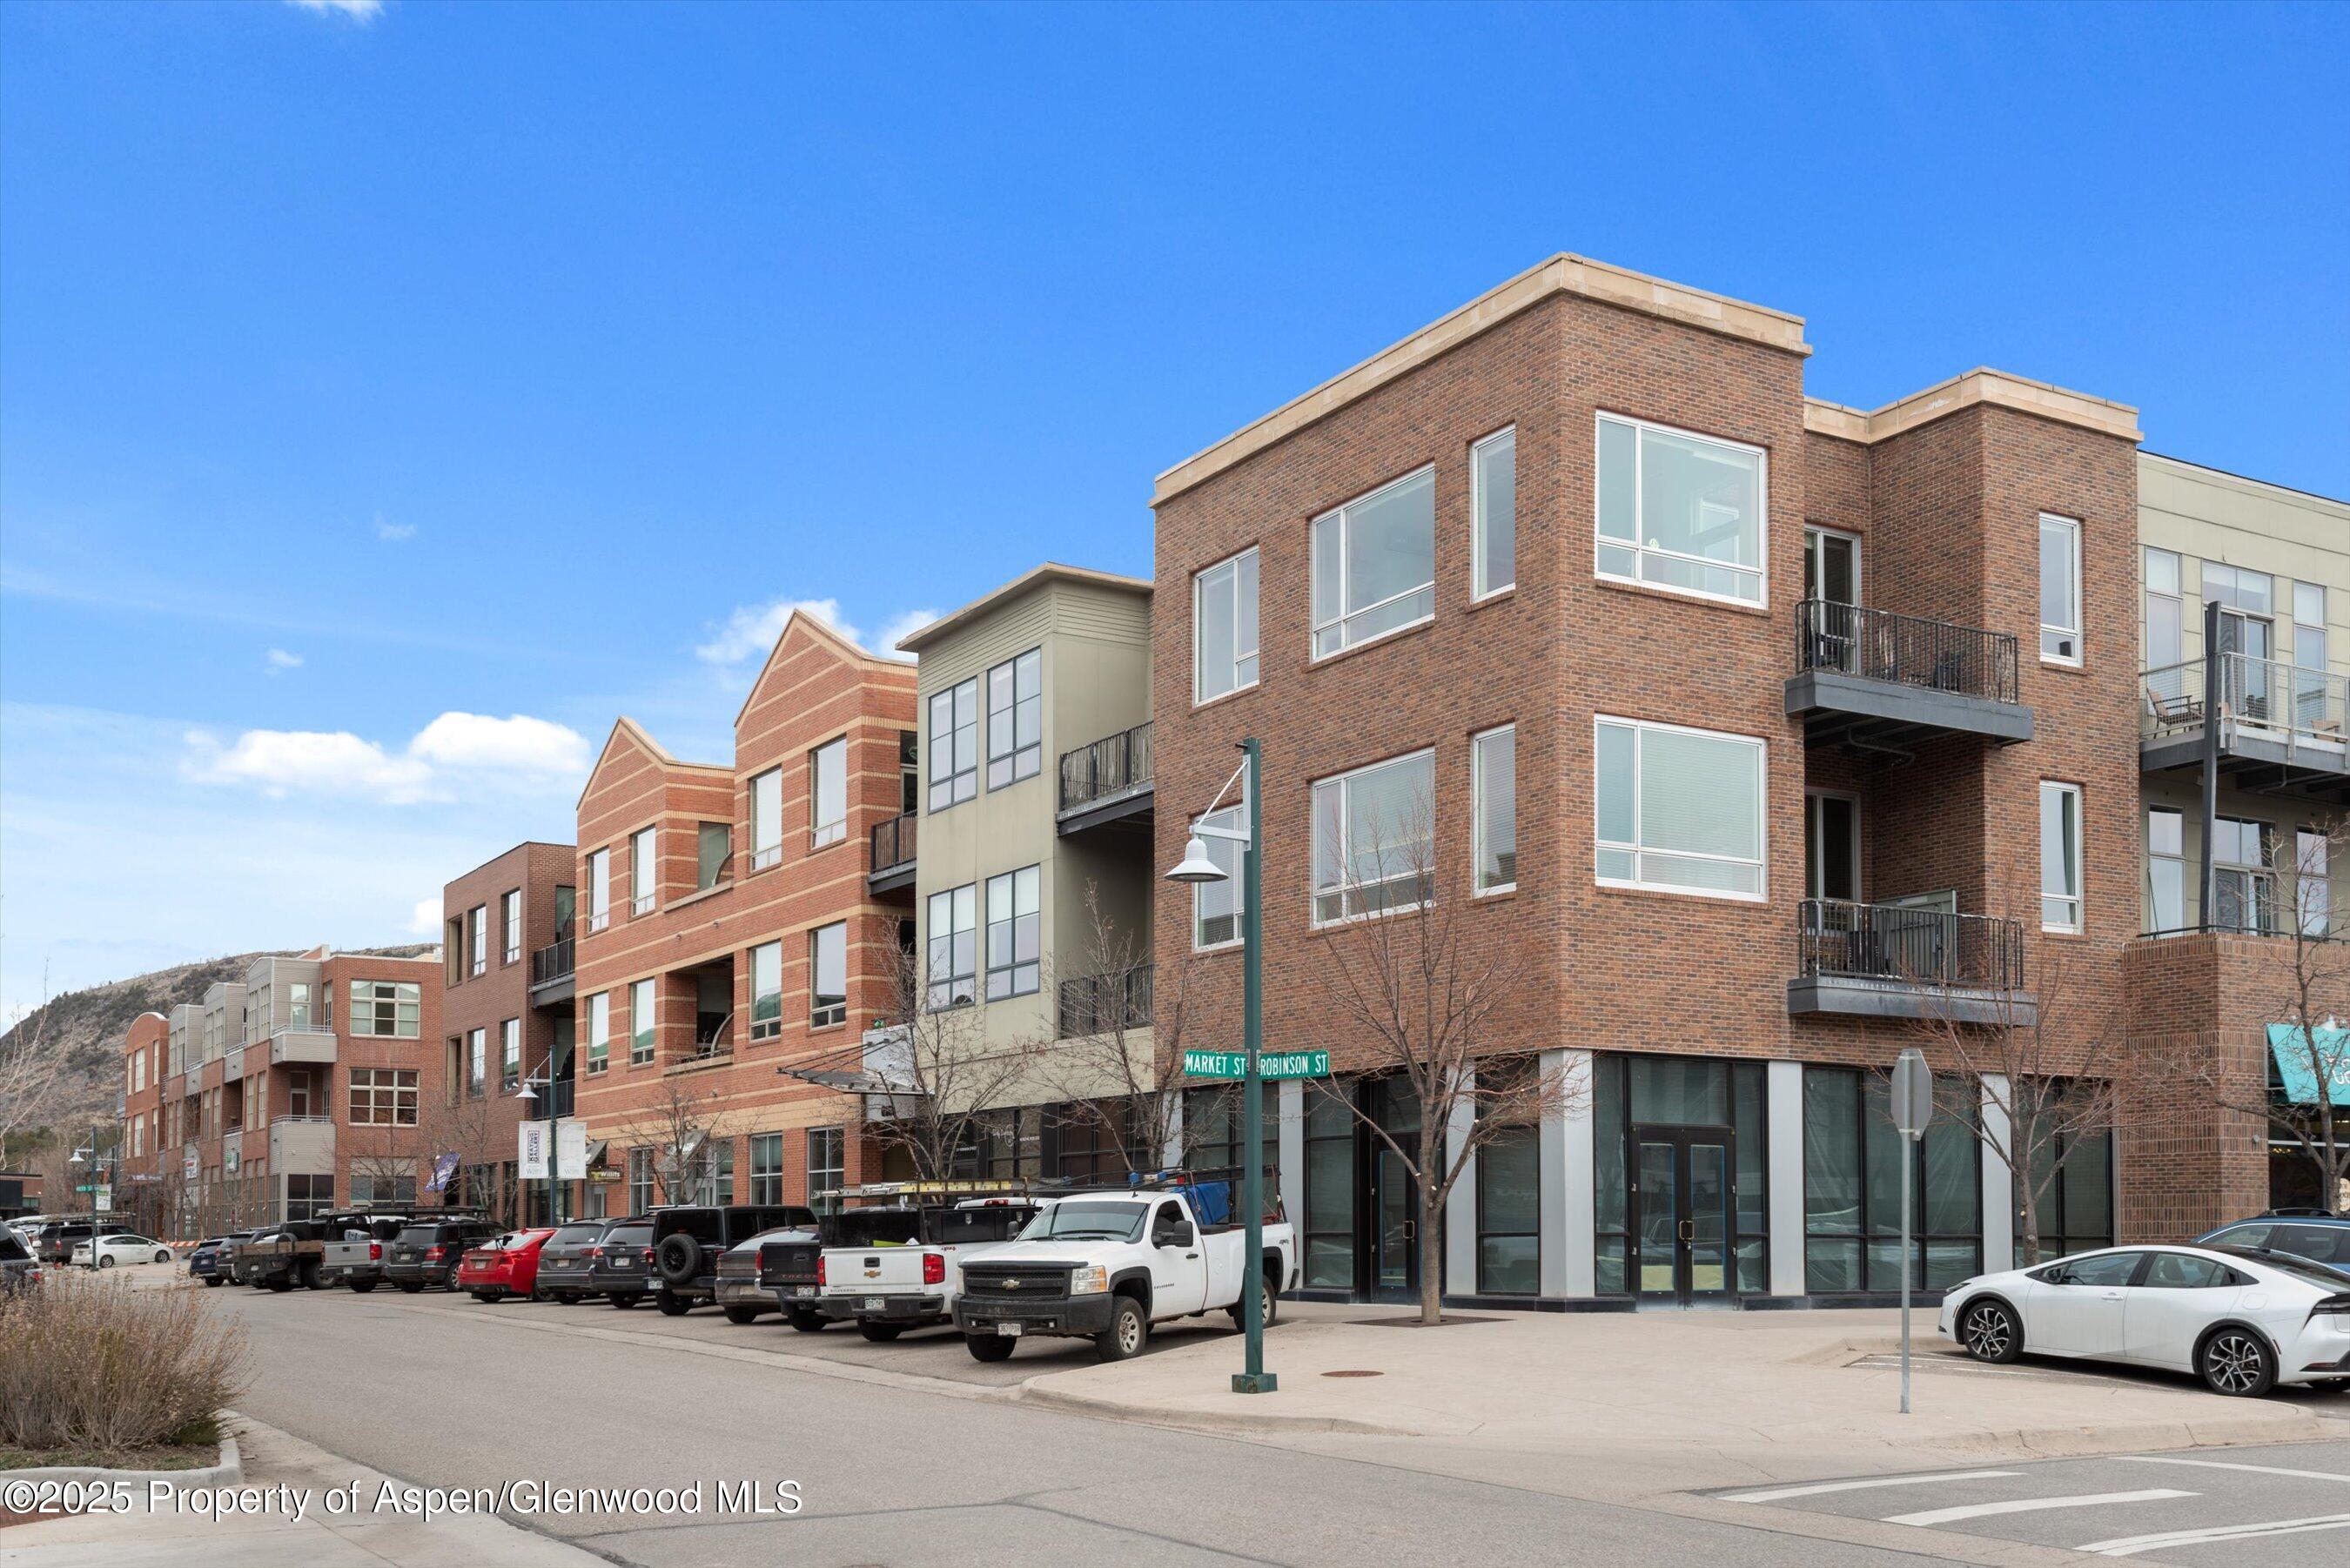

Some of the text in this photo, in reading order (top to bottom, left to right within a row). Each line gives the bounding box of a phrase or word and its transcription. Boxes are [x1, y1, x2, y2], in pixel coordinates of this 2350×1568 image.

[1185, 1054, 1246, 1075] MARKET ST
[1260, 1054, 1327, 1076] ROBINSON ST
